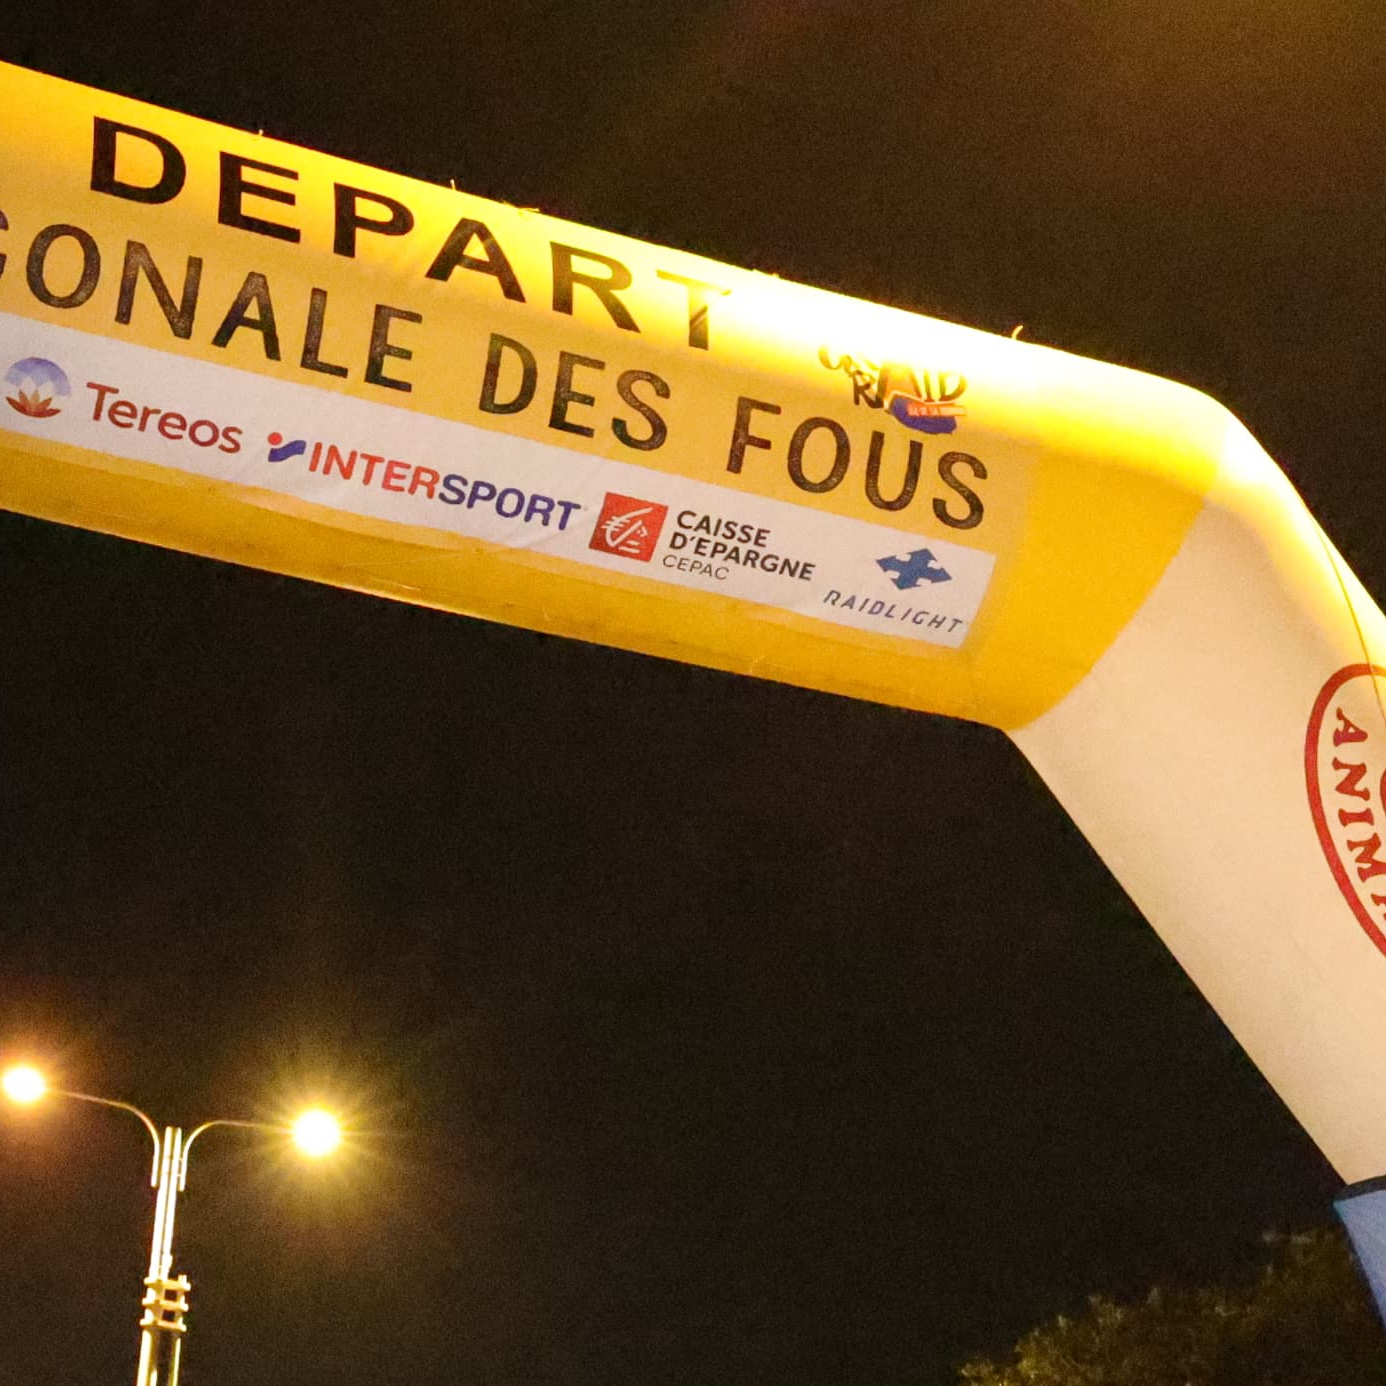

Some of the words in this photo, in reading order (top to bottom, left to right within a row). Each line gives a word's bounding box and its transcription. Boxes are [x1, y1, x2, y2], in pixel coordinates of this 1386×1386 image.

[90, 115, 732, 350] DEPART
[86, 381, 243, 454] Tereos
[479, 332, 671, 452] DES
[725, 396, 989, 530] FOUS
[309, 441, 581, 532] INTERSPORT
[669, 531, 816, 582] D'EPARGNE
[676, 510, 771, 548] CAISSE
[662, 554, 730, 580] CEPAC
[822, 589, 963, 633] RAIDLIGHT
